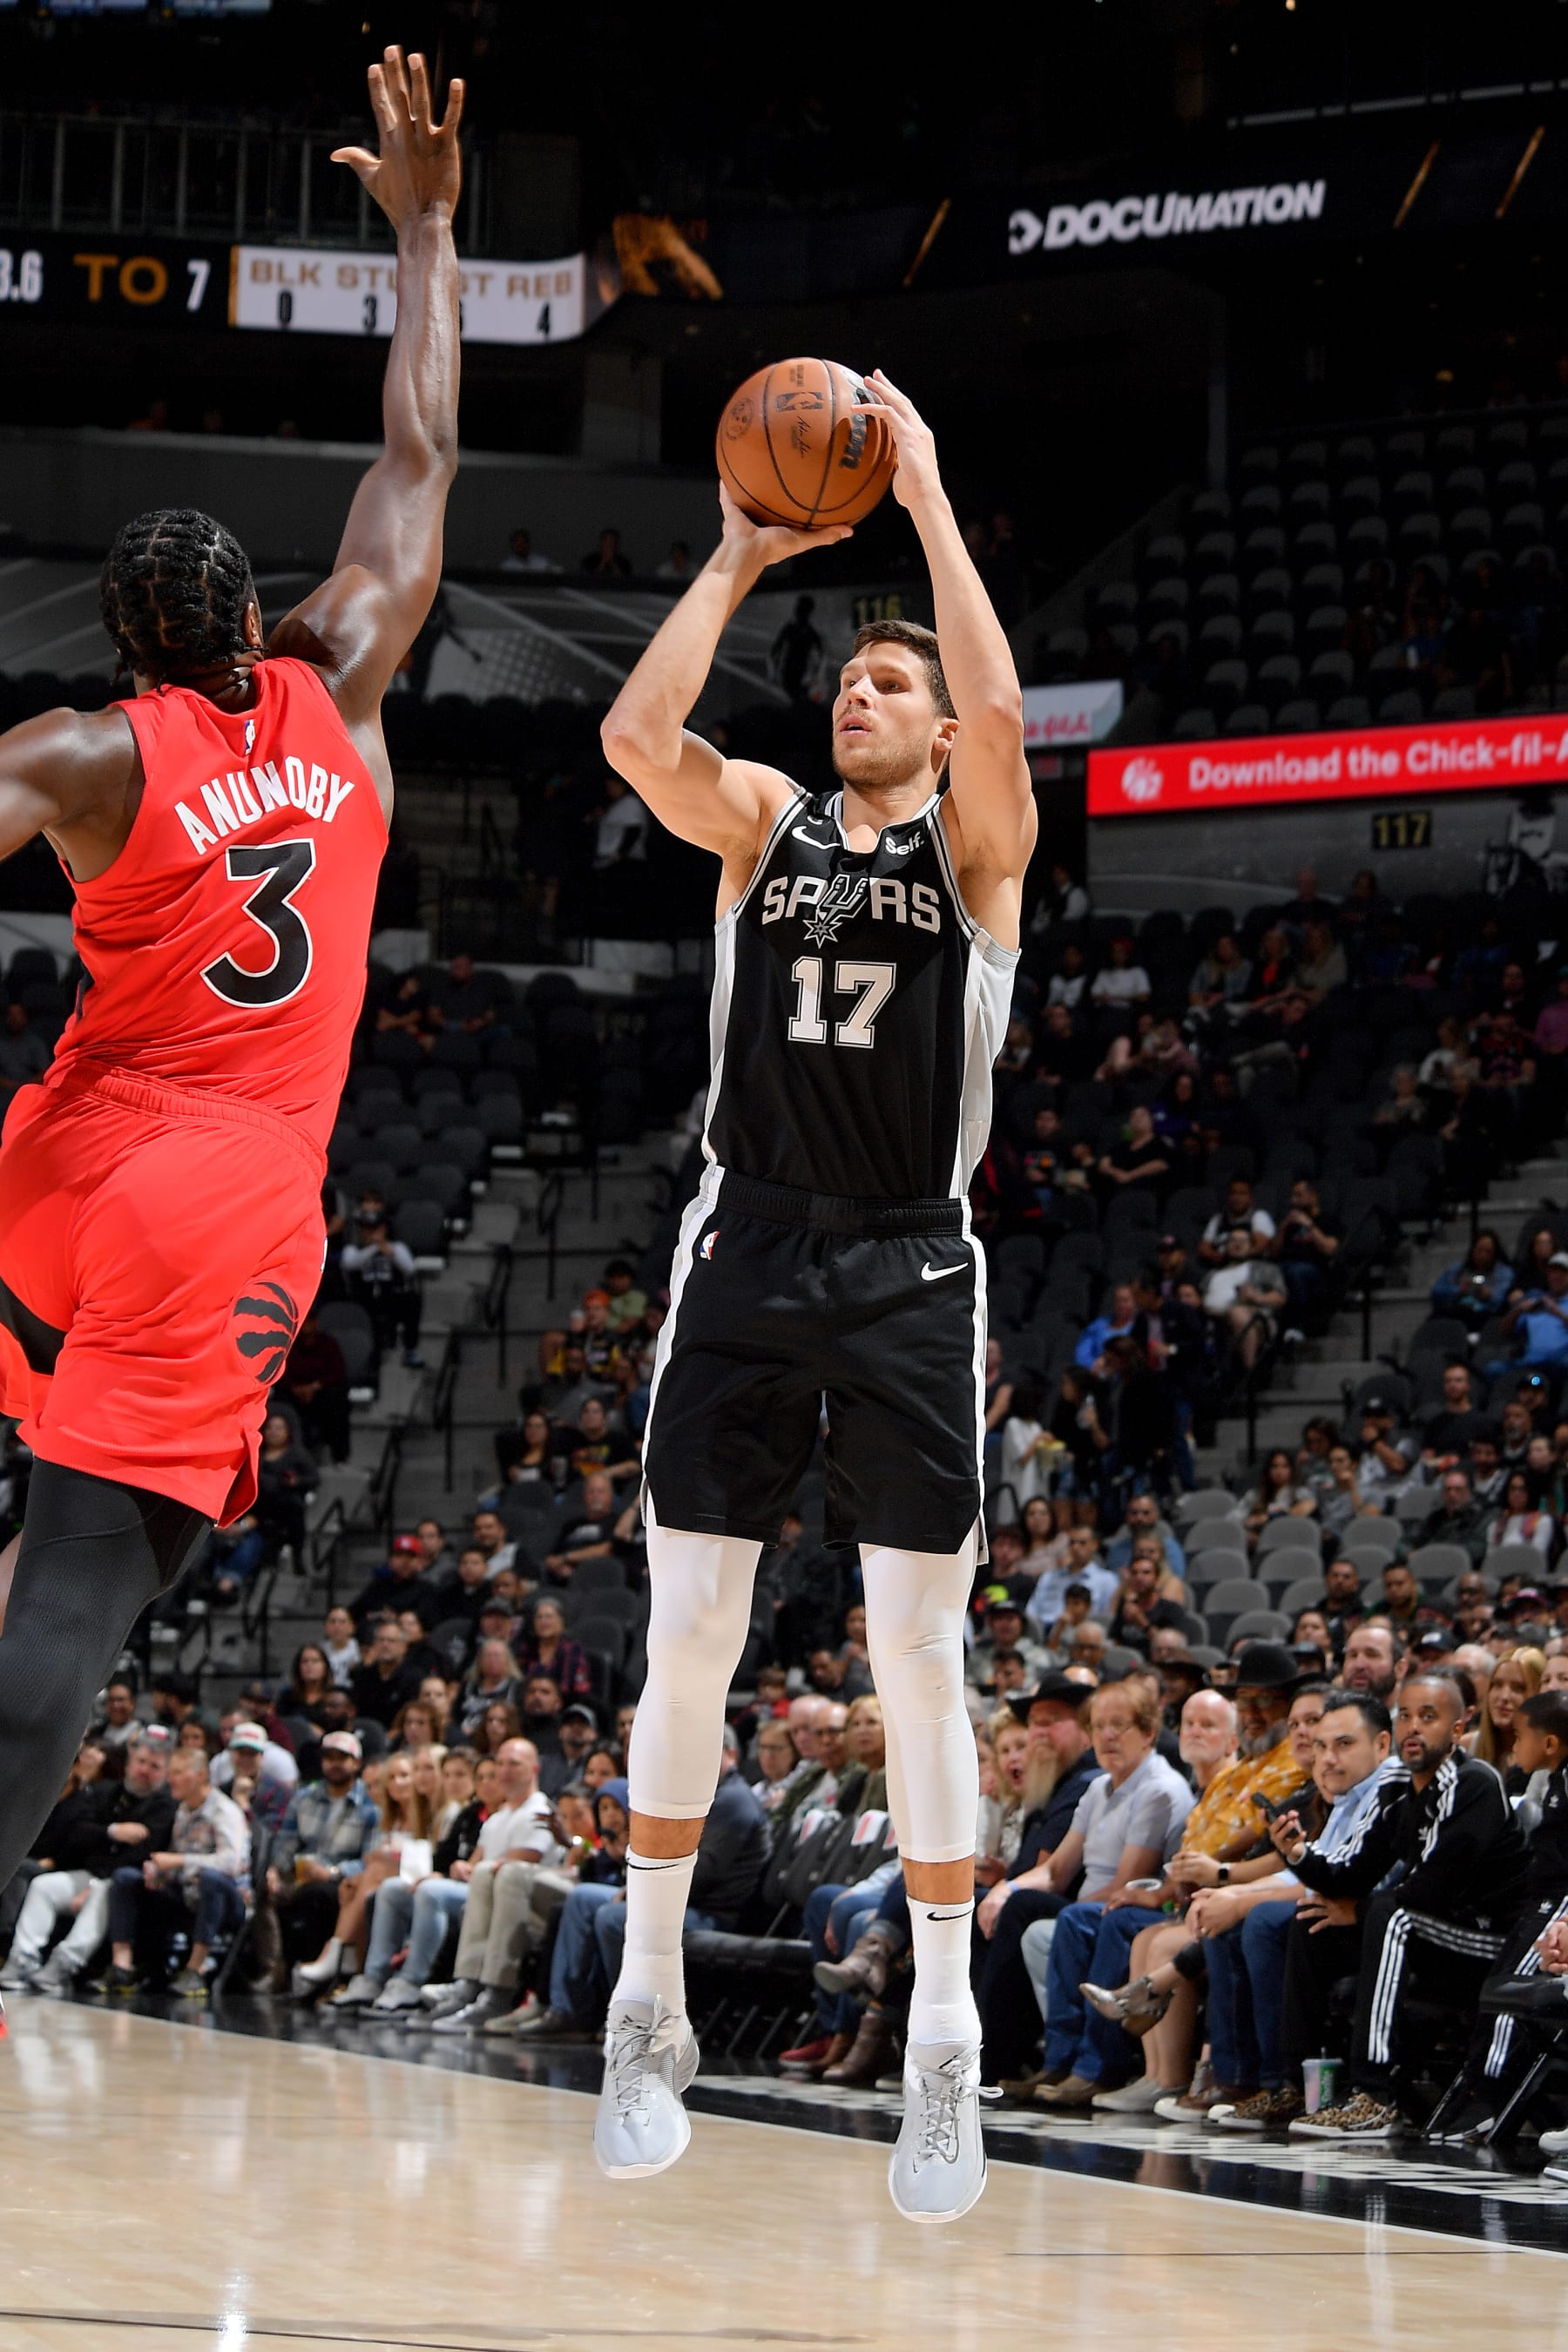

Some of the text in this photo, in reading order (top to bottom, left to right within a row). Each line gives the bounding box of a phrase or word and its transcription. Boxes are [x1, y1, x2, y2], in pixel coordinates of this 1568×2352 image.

[1044, 180, 1326, 249] DOCUMATION
[73, 253, 167, 304] TO
[187, 260, 210, 311] 7
[251, 259, 321, 287] BLK
[507, 270, 571, 298] REB
[278, 289, 293, 328] 0
[537, 303, 551, 336] 4
[1188, 747, 1341, 790] Download
[1347, 745, 1401, 779] the
[173, 755, 355, 855] ANUNOBY
[1376, 812, 1429, 847] 117
[199, 838, 316, 1008] 3
[761, 873, 941, 949] SPURS
[787, 956, 897, 1049] 17
